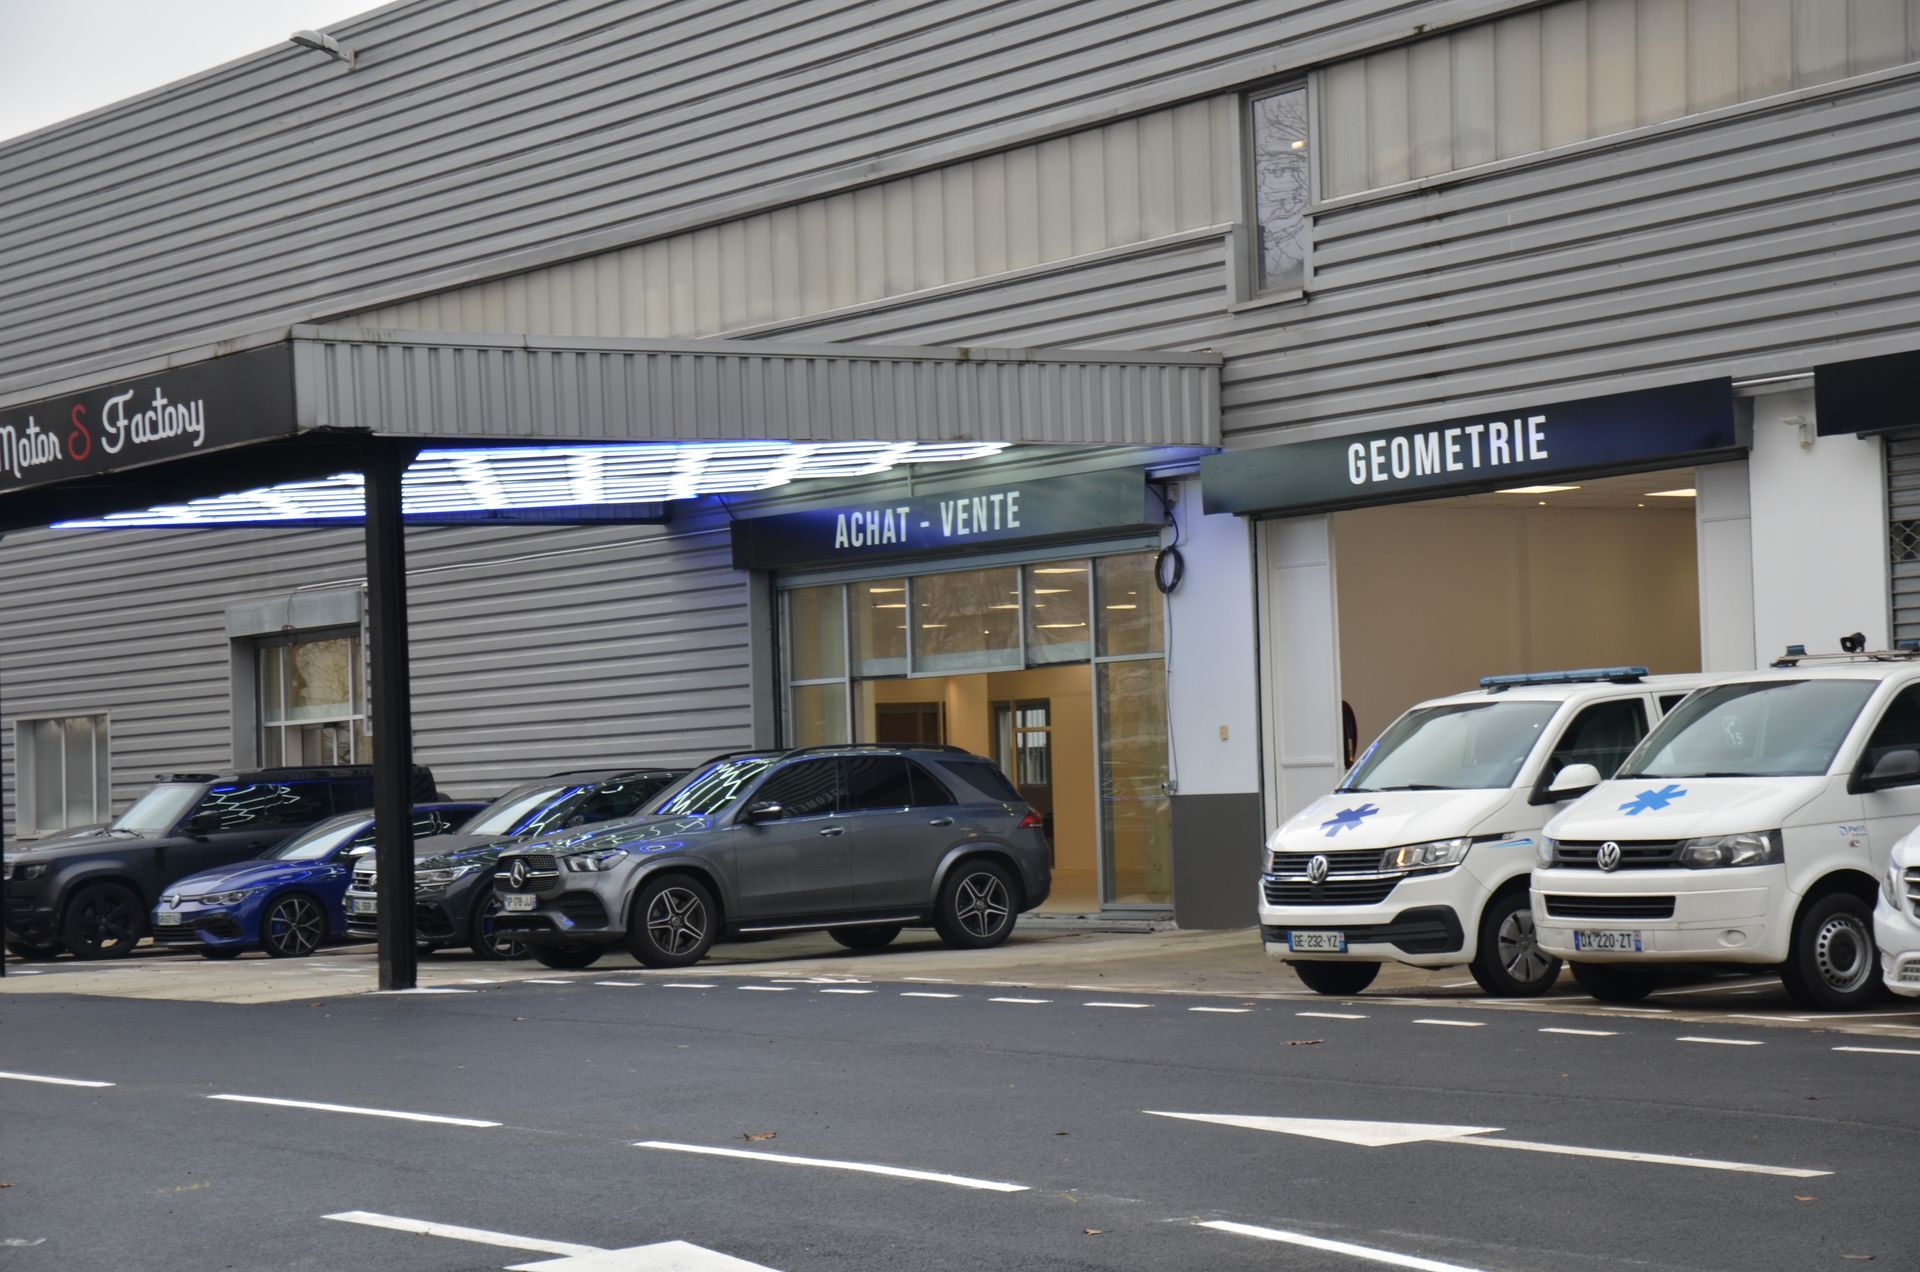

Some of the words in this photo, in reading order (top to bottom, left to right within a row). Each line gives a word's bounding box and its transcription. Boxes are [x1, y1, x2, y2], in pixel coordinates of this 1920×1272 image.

[101, 387, 206, 454] Factory
[1347, 414, 1549, 485] GEOMETRIE
[835, 506, 910, 549] ACHAT
[940, 491, 1021, 537] VENTE
